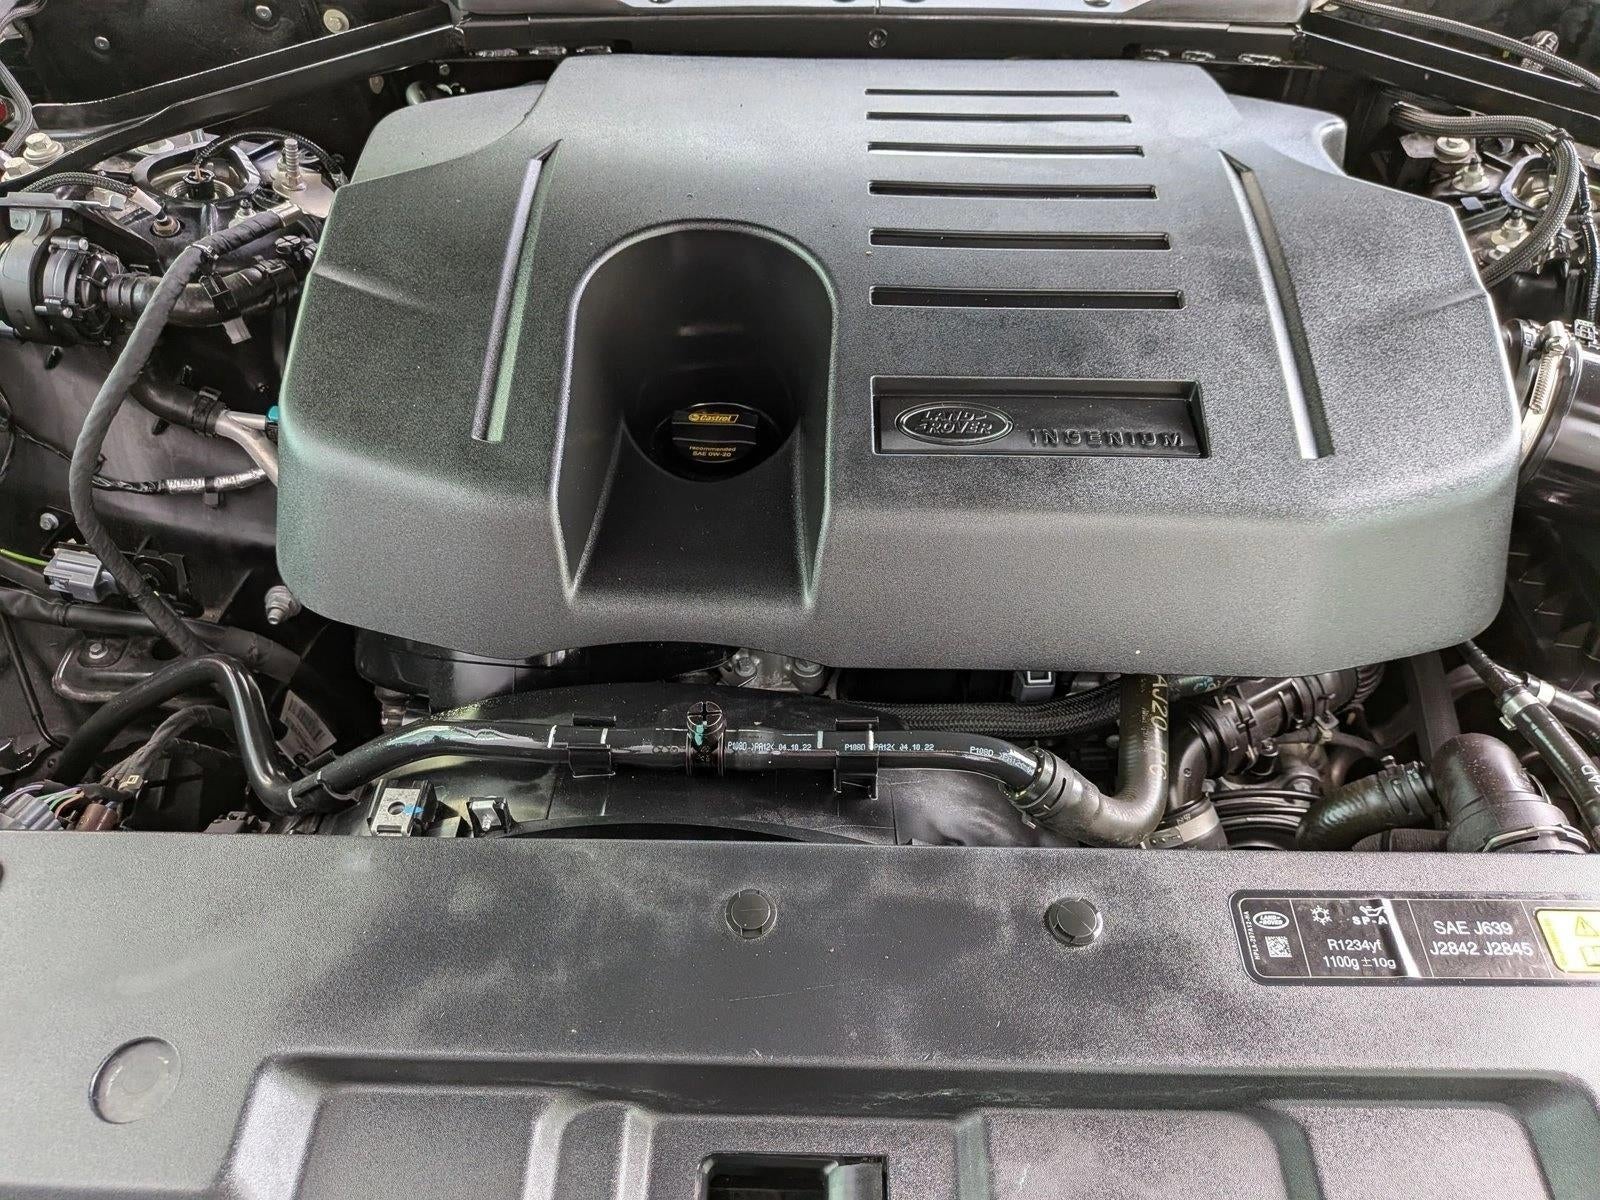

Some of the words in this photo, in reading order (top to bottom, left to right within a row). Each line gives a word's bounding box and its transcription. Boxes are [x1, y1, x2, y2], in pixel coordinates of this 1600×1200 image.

[700, 414, 731, 423] Castrol
[928, 421, 993, 435] ROVER
[1029, 428, 1184, 447] INGENIUM
[1351, 915, 1388, 926] SP-A
[1433, 920, 1471, 935] SAE
[1473, 920, 1514, 936] J639
[1327, 938, 1382, 954] R1234yf
[1429, 940, 1481, 956] J2842
[1483, 940, 1534, 957] J2845
[1322, 955, 1360, 971] 1100g
